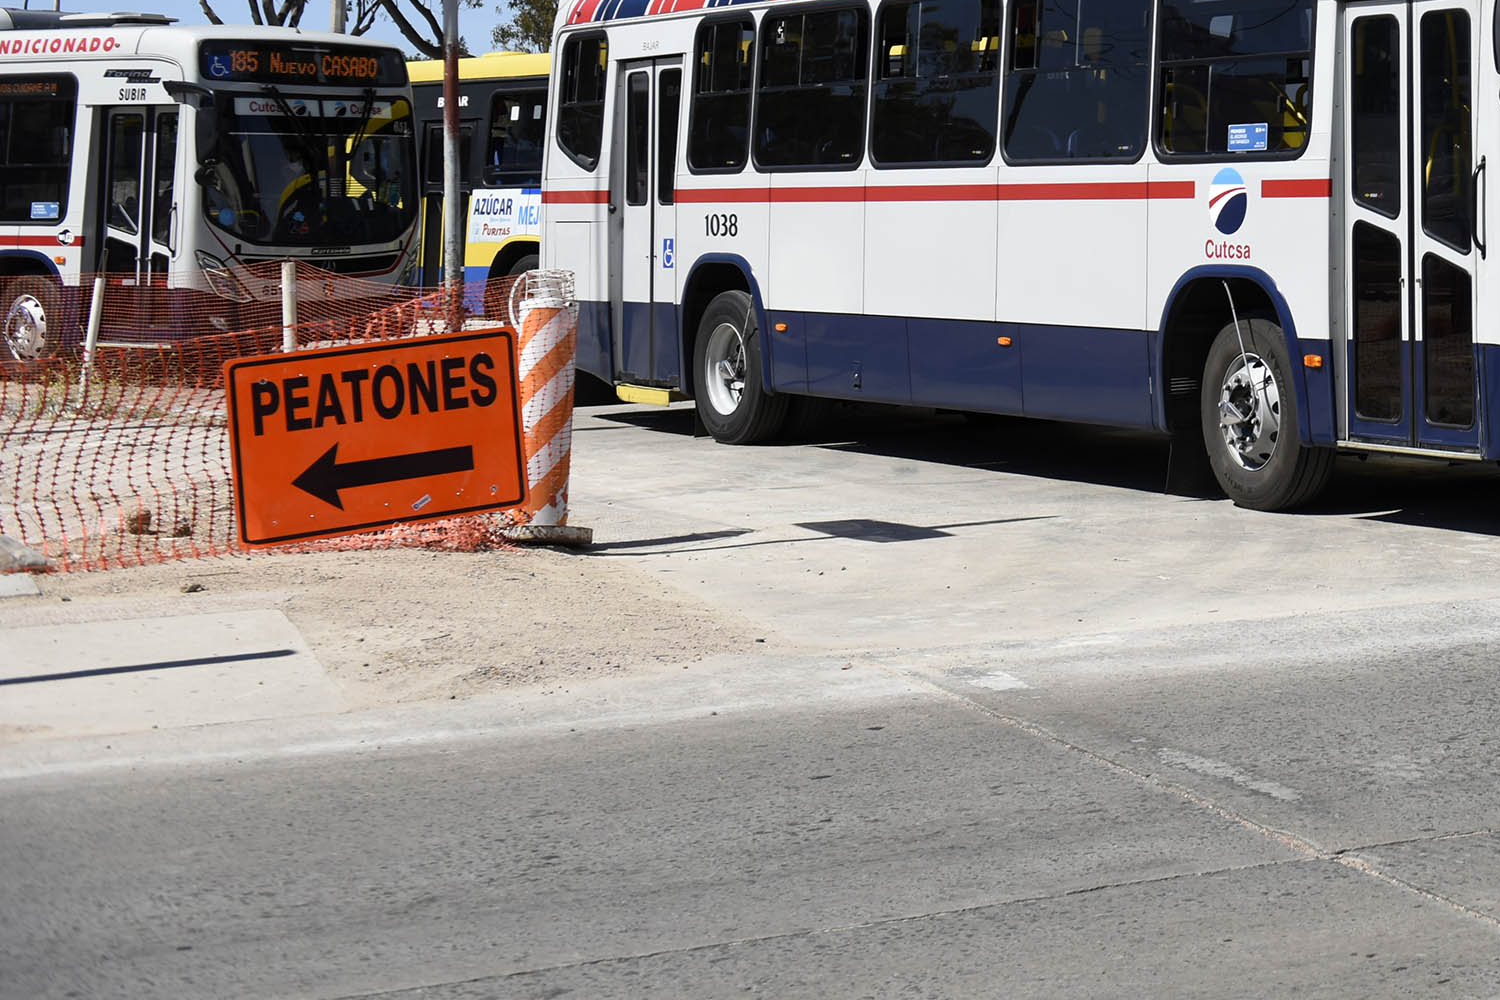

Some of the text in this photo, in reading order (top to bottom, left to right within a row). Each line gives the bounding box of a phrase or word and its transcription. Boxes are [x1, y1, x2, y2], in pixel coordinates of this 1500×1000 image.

[230, 51, 258, 72] 185
[322, 56, 378, 77] CASABO
[119, 88, 147, 101] SUBIR
[249, 101, 286, 113] Cutcs
[474, 194, 513, 215] AZÚCAR
[704, 214, 738, 237] 1038
[1205, 239, 1251, 259] Cutcsa
[250, 353, 497, 436] PEATONES
